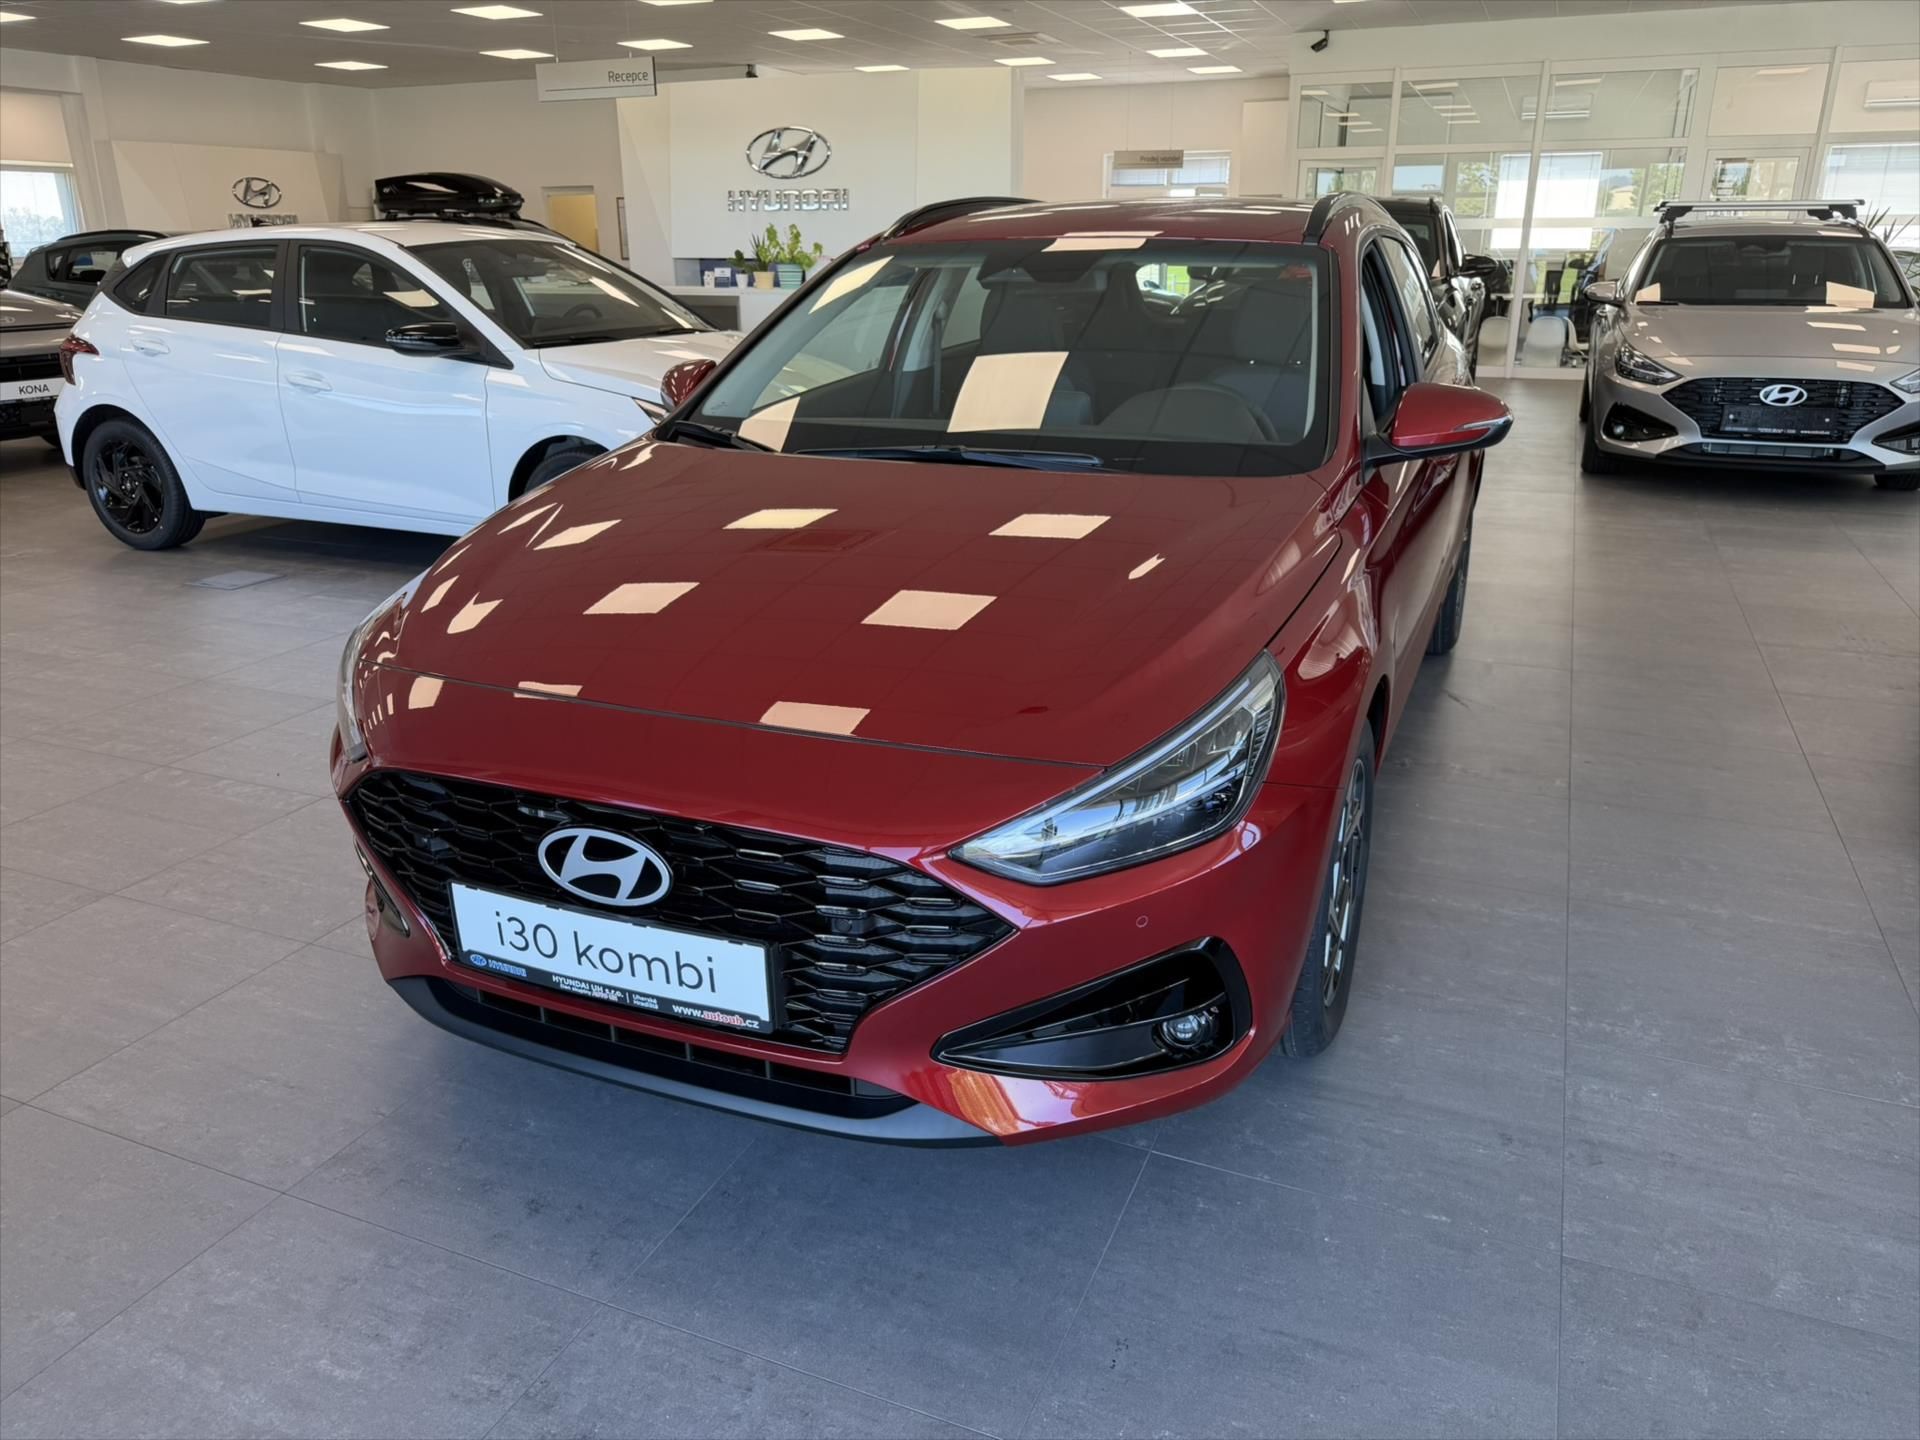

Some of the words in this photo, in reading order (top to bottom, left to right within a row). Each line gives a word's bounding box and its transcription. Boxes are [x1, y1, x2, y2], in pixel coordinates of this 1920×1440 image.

[607, 70, 649, 83] Recepce
[728, 188, 849, 212] HYUNDAI
[18, 383, 50, 395] KONA
[495, 910, 559, 959] i30
[573, 930, 716, 993] kombi
[552, 975, 589, 990] HYUNDAI
[590, 983, 603, 994] UH
[605, 988, 624, 998] s.r.o.
[672, 1004, 760, 1029] www.autouh.cz
